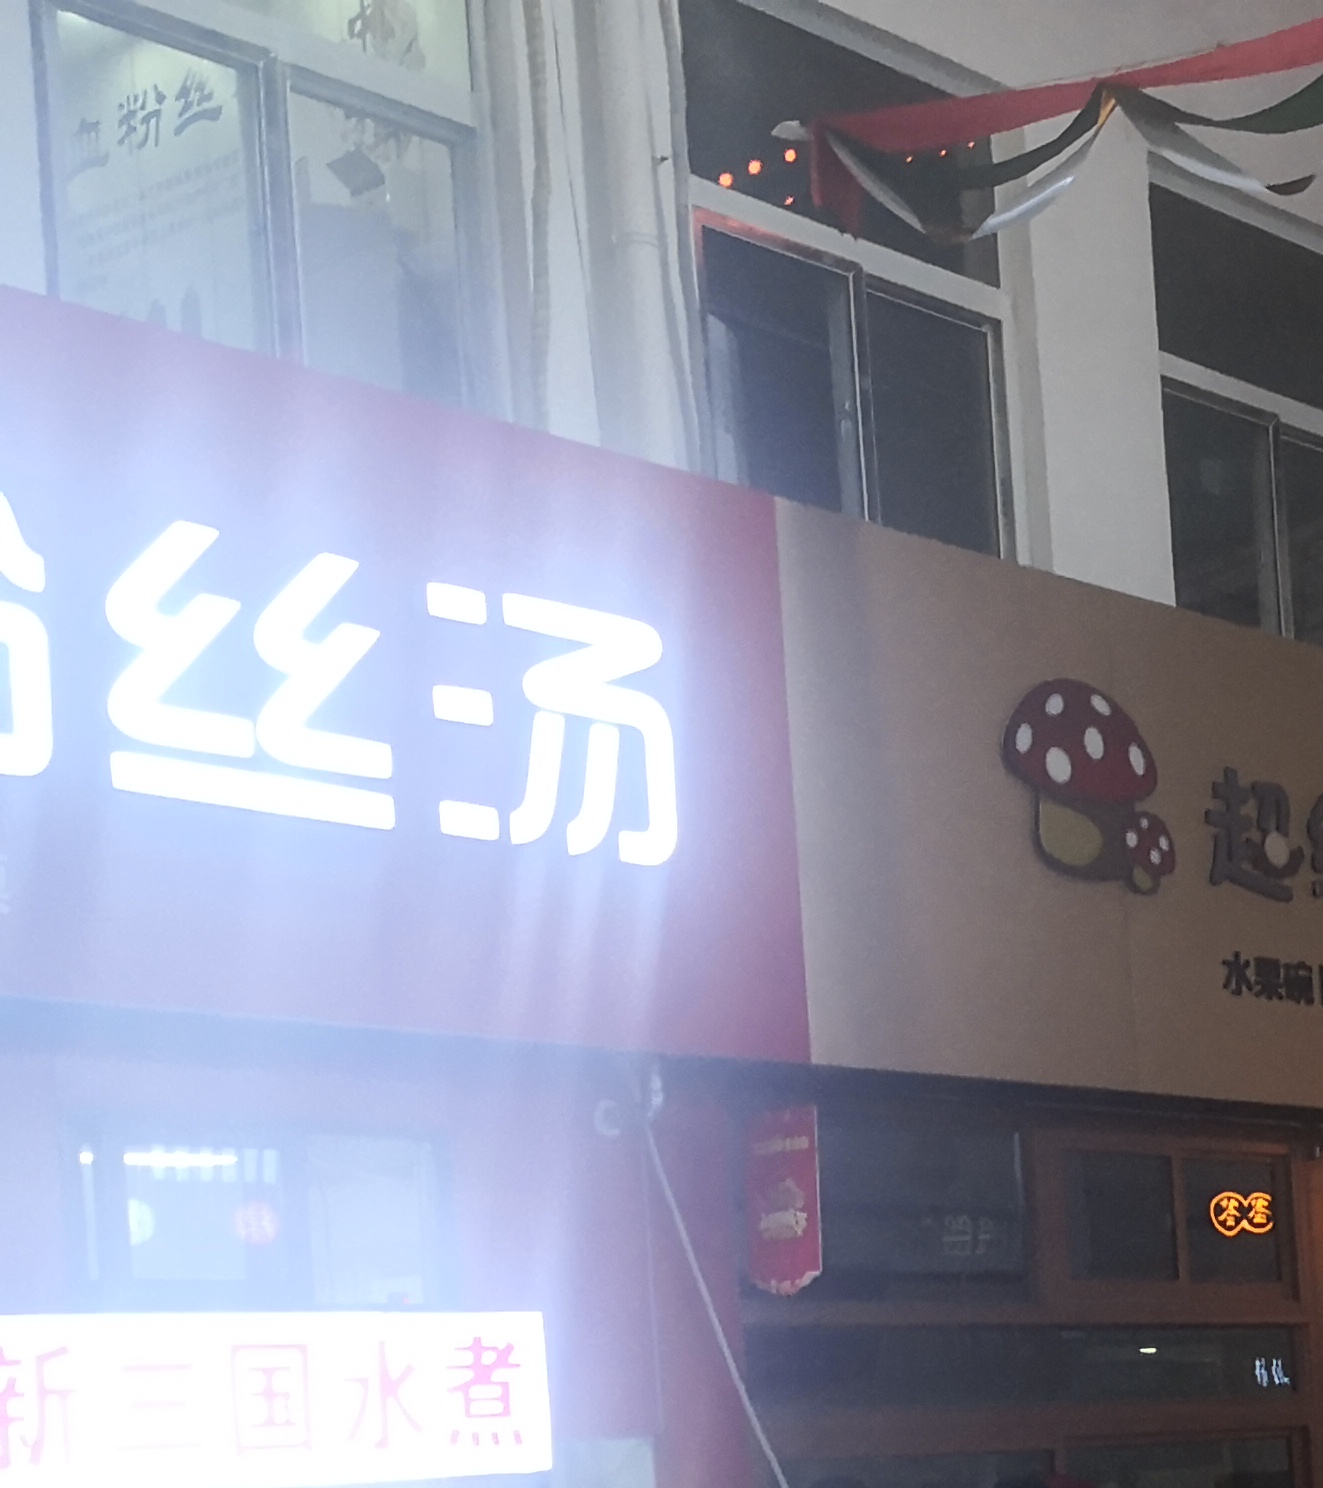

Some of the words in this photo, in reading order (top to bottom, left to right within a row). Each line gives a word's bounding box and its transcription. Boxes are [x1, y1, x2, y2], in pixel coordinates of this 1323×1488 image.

[0, 1335, 523, 1468] 新三国水煮
